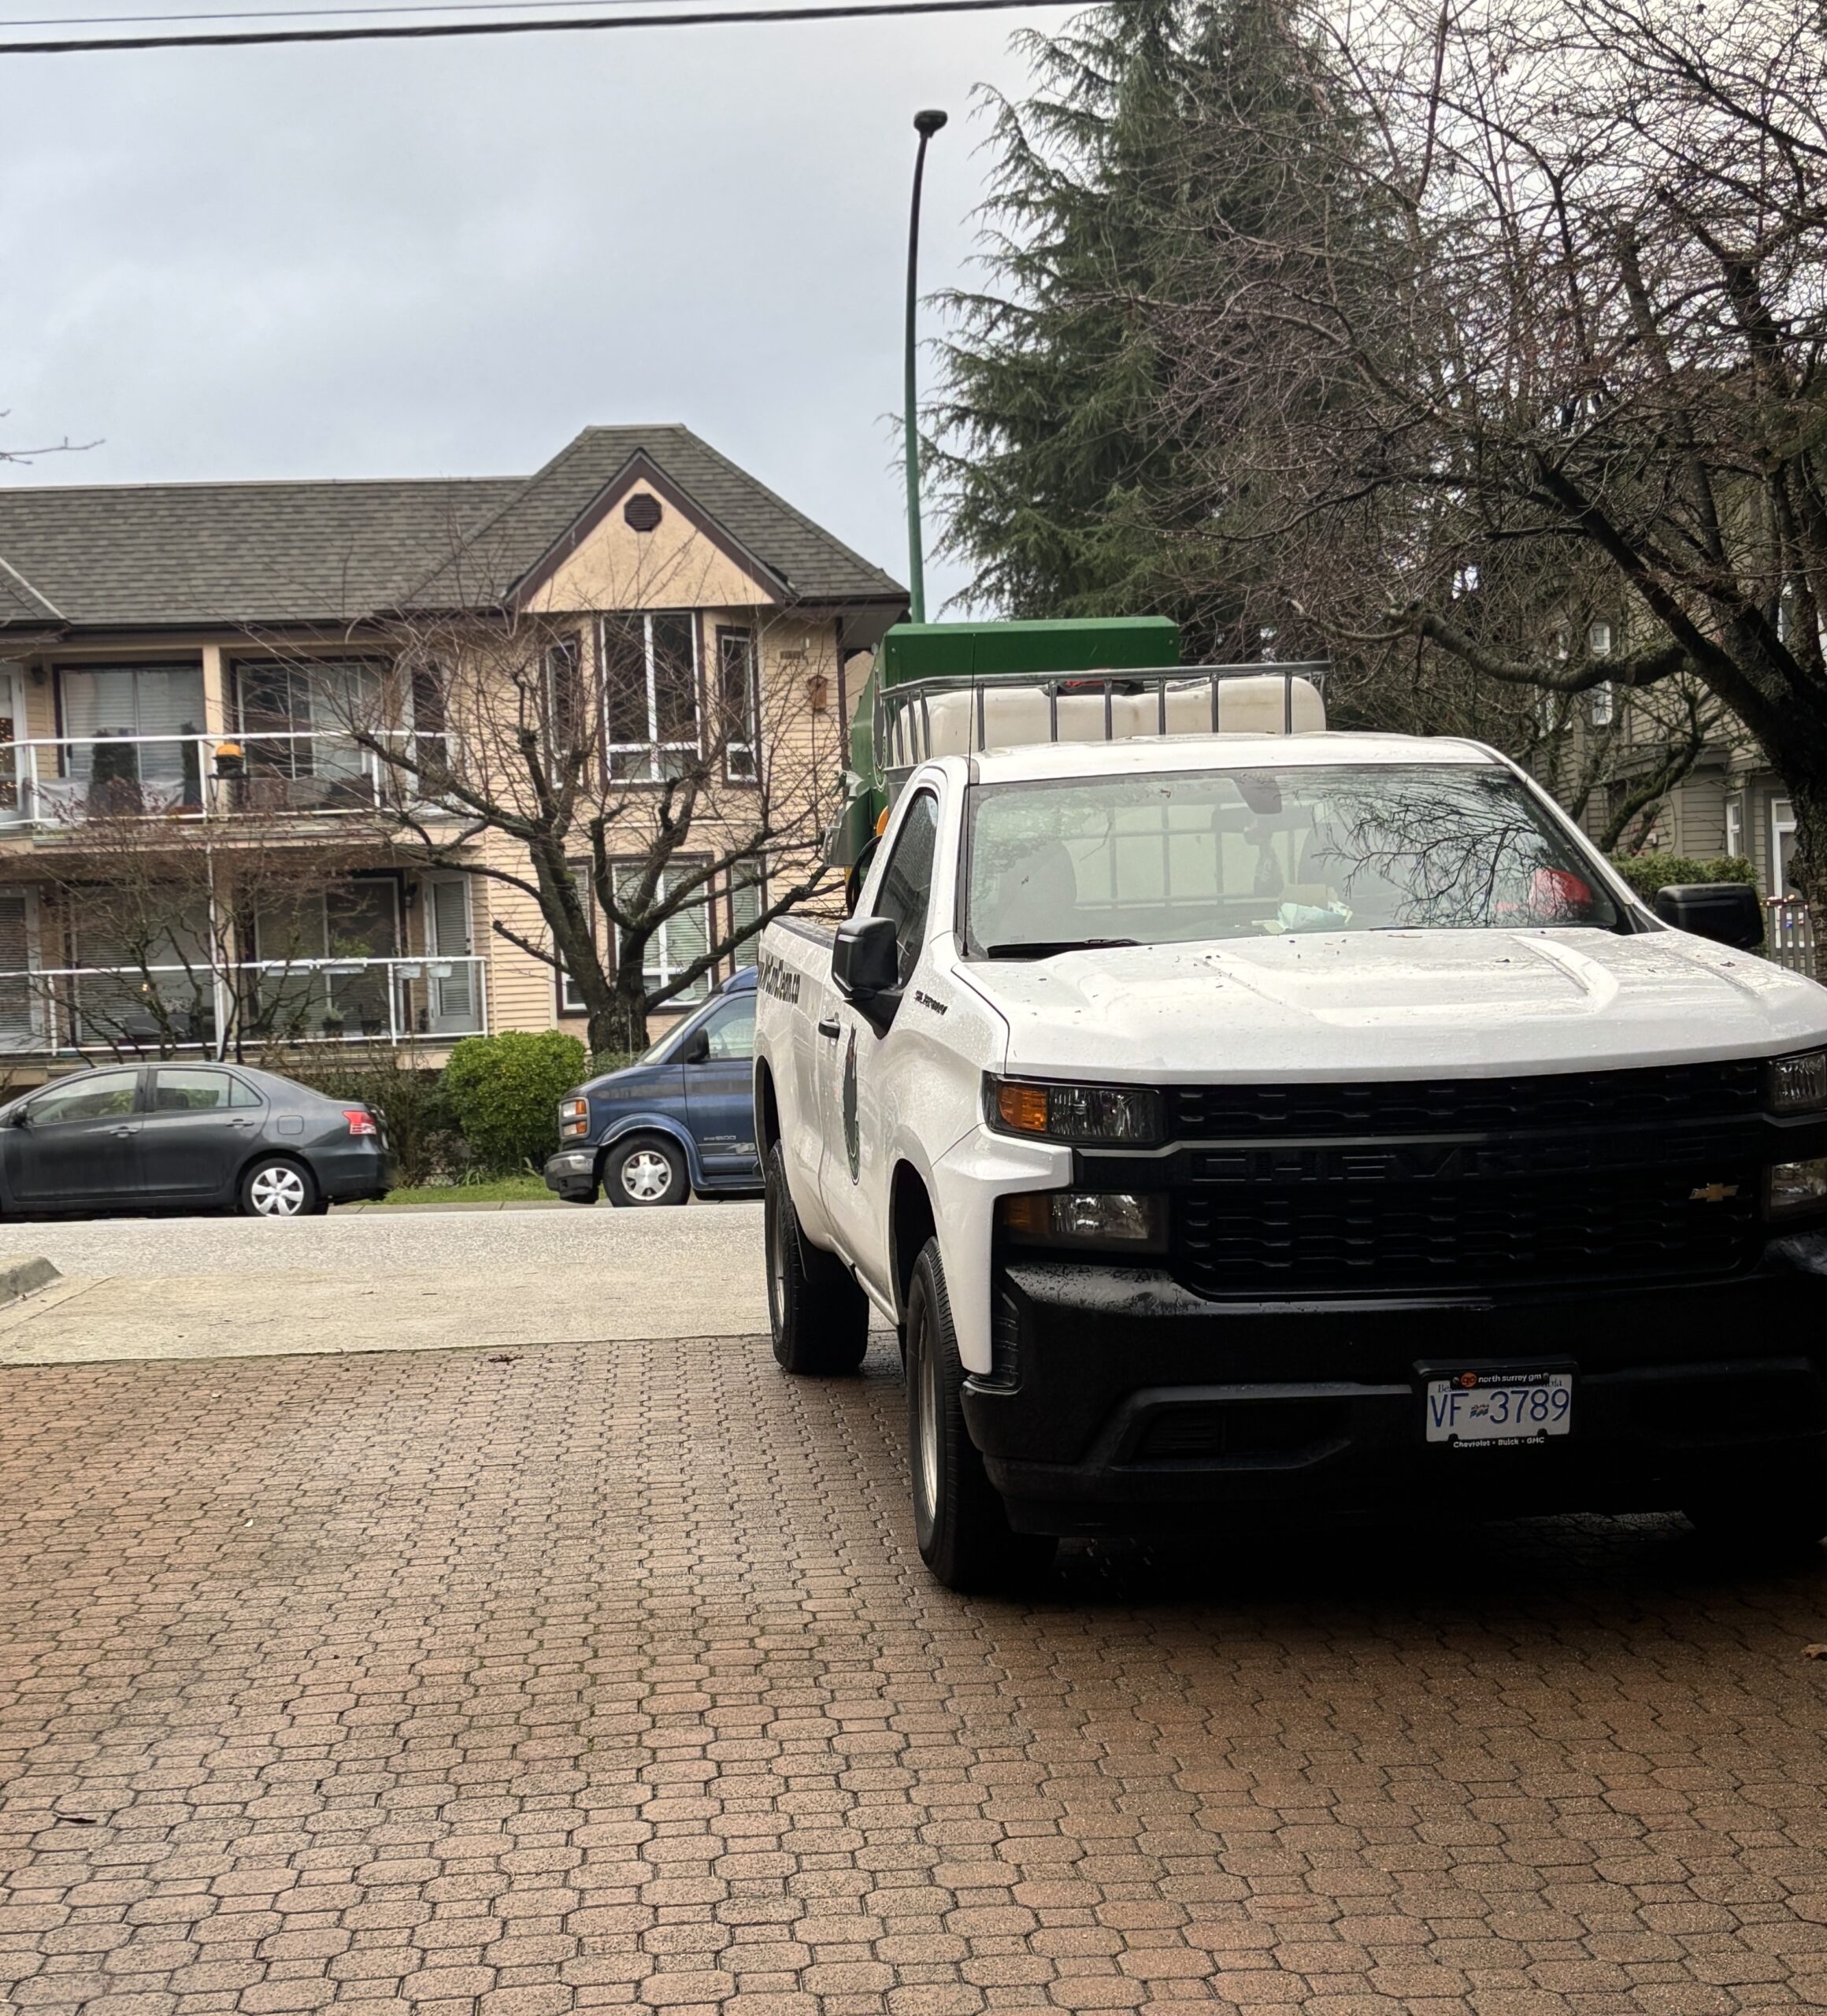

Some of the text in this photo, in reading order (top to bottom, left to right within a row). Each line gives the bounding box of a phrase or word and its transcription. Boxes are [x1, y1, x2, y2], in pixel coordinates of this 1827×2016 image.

[1478, 1374, 1501, 1384] north
[1502, 1374, 1528, 1383] surrey
[1529, 1373, 1542, 1382] gm
[1430, 1388, 1570, 1428] VF 3789
